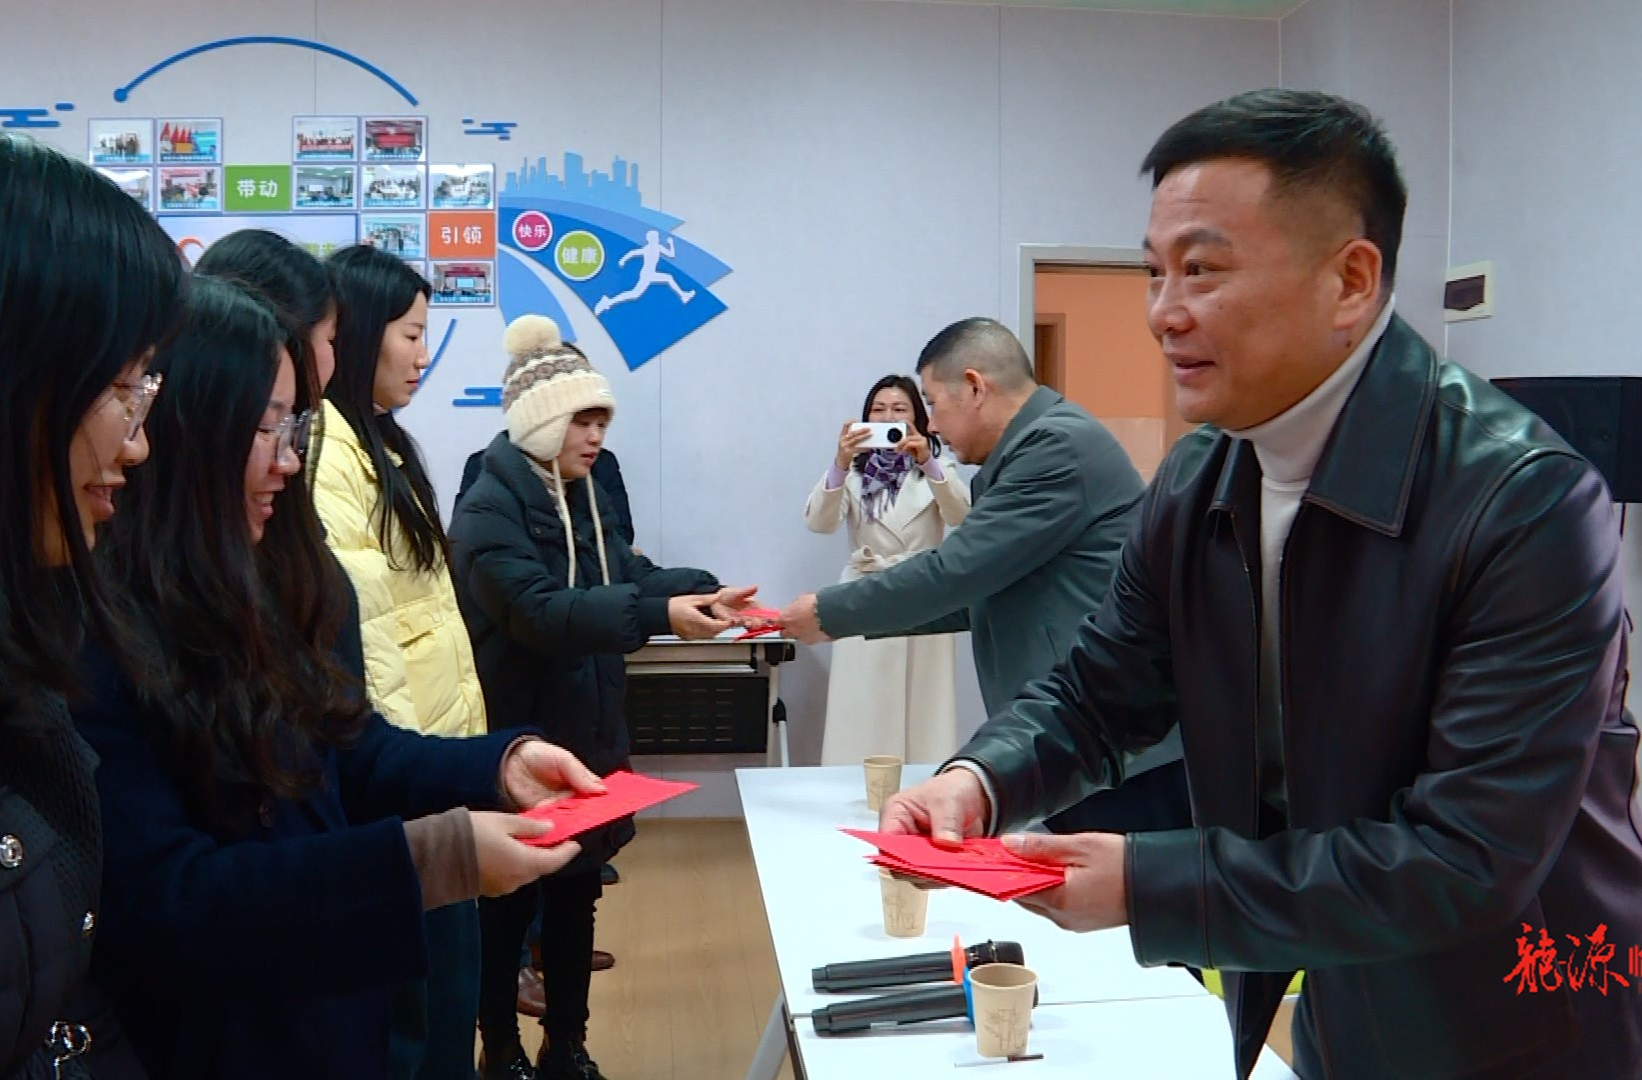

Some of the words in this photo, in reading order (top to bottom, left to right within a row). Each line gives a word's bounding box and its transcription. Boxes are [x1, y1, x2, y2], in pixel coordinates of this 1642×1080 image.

[237, 179, 278, 198] 带动
[441, 226, 482, 244] 引领
[518, 223, 548, 239] 快乐
[562, 246, 598, 265] 健康
